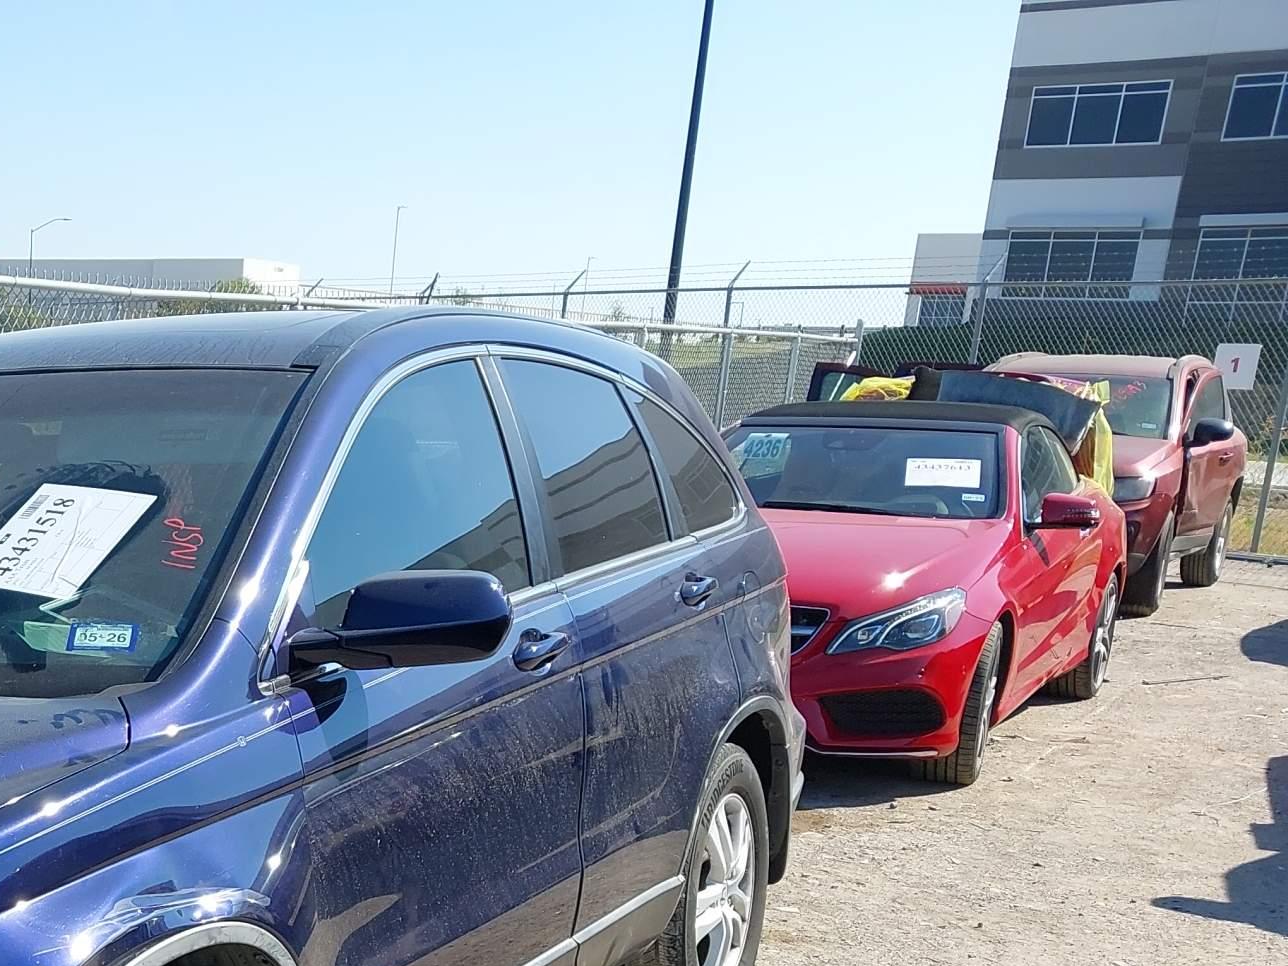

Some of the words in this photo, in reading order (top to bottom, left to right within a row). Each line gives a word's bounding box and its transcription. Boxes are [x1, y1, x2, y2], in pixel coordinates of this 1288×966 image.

[1231, 357, 1241, 373] 1
[743, 439, 782, 458] 4236
[159, 517, 204, 569] INSP
